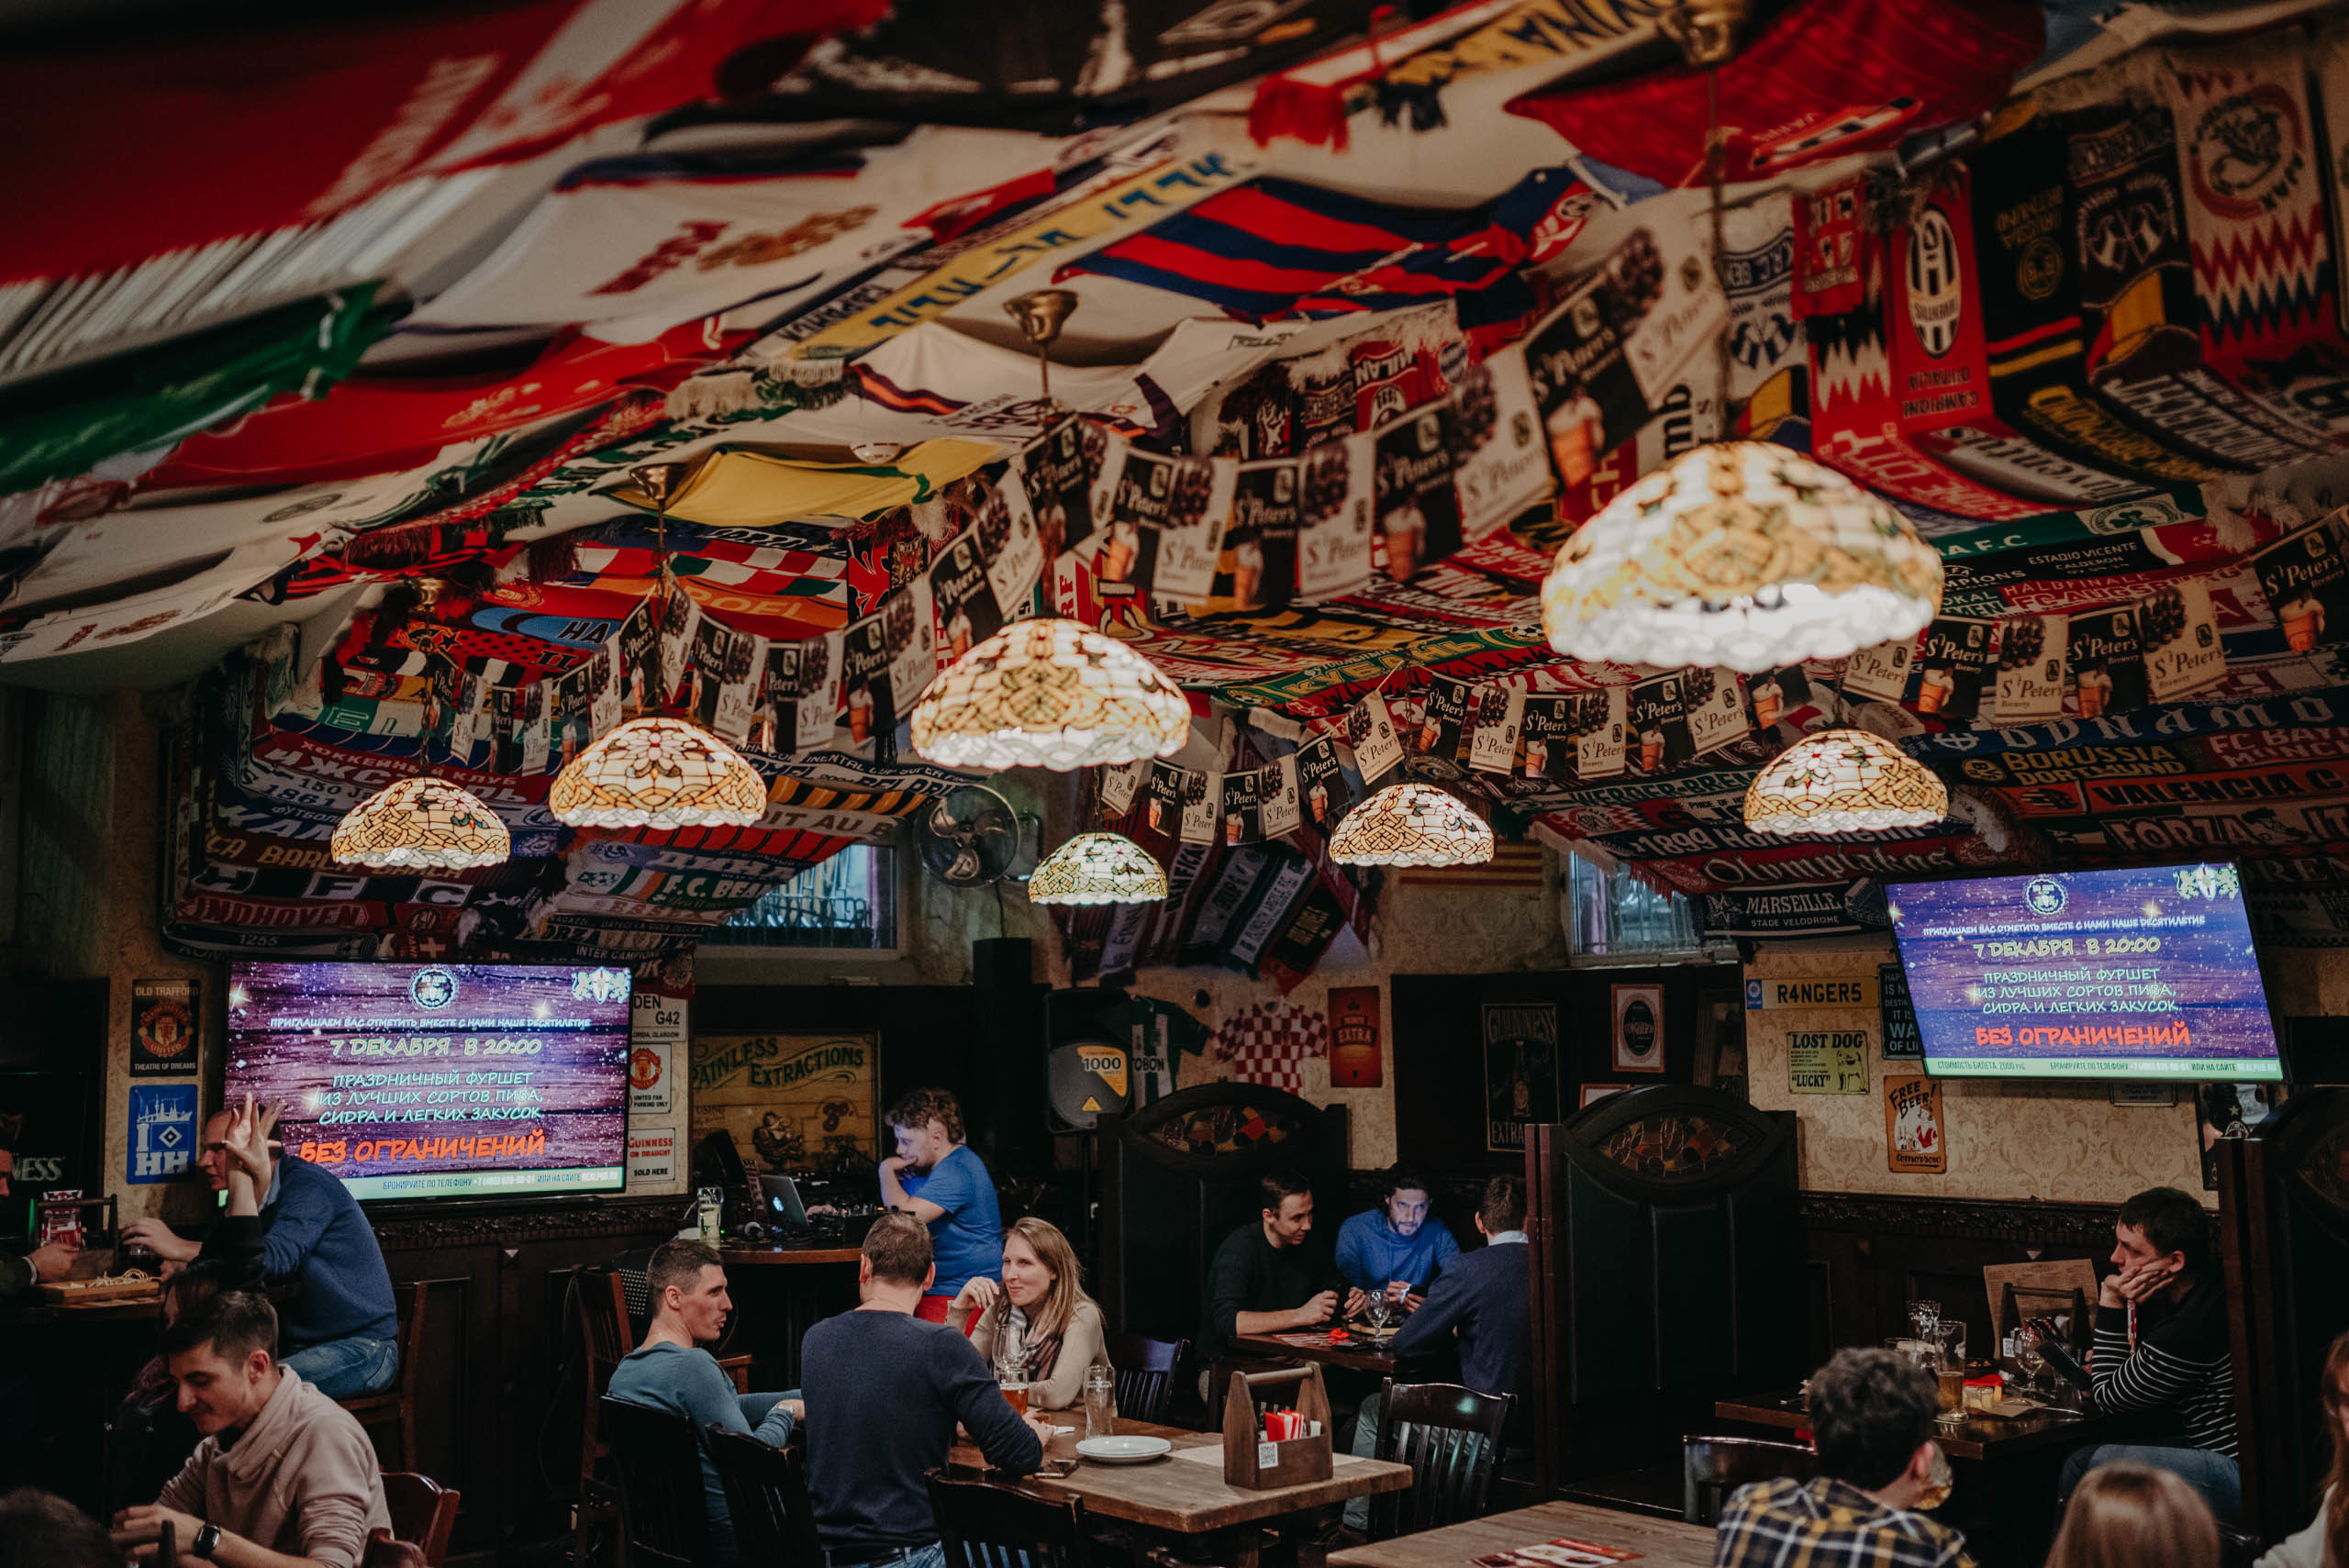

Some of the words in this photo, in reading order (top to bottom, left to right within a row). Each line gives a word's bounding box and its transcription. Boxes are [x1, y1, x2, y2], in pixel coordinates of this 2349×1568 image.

[1354, 349, 1414, 385] MILAN
[1902, 391, 1980, 418] CAMPIONI
[2027, 550, 2082, 566] ESTADIO
[2084, 541, 2138, 559] VICENTE
[2054, 555, 2124, 571] CALDERON
[2287, 552, 2342, 588] Peter's
[2003, 573, 2152, 596] HALBFINALE
[1942, 641, 1985, 663] Peter's
[2090, 638, 2139, 659] Peter's
[1285, 639, 1486, 695] КУБАНЬ
[2176, 648, 2225, 673] Peter's
[1867, 661, 1908, 684] Peter's
[2021, 680, 2062, 699] Peter's
[1437, 694, 1465, 717] Peter's
[1647, 700, 1685, 721] Peter's
[1537, 715, 1568, 732] Peter's
[1707, 708, 1745, 730] Peter's
[1369, 735, 1400, 761] Peter's
[1595, 741, 1625, 759] Peter's
[2210, 733, 2254, 756] FC
[2000, 745, 2177, 771] BORUSSIA
[1308, 756, 1337, 780] Peter's
[2013, 760, 2188, 786] DORTMUND
[299, 777, 341, 795] 150
[453, 771, 519, 785] КЛУБ
[264, 784, 336, 808] 1861
[1157, 777, 1177, 800] Peter's
[1232, 790, 1258, 805] Peter's
[2091, 773, 2306, 807] VALENCIA
[1688, 799, 1716, 809] PRIDE
[1719, 798, 1728, 806] OF
[813, 815, 863, 831] AU
[2100, 813, 2255, 853] FORZA
[1746, 892, 1843, 916] MARSEILLE
[1751, 917, 1781, 928] STADE
[1783, 915, 1841, 927] VELODROME
[1923, 926, 1977, 936] ПРИГЛАШАЕМ
[1979, 925, 1996, 934] ВАС
[1997, 923, 2040, 933] ОТМЕТИТЬ
[2042, 922, 2074, 931] ВМЕСТЕ
[2084, 920, 2110, 929] НАМИ
[2112, 918, 2139, 929] НАШЕ
[2140, 915, 2205, 928] ДЕСЯТИЛЕТИЕ
[237, 933, 279, 947] 1255
[1974, 943, 1985, 957] 7
[1988, 939, 2074, 956] ДЕКАБРЯ
[2086, 939, 2099, 955] В
[2105, 937, 2161, 954] 20:00
[576, 945, 607, 959] INTER
[1984, 967, 2091, 984] ПРАЗДНИЧНЫЙ
[2097, 967, 2160, 981] ФУРШЕТ
[135, 986, 152, 996] OLD
[155, 985, 198, 996] TRAFFORD
[1886, 984, 1894, 994] IS
[1977, 988, 1996, 999] ИЗ
[1999, 986, 2062, 999] ЛУЧШИХ
[2066, 984, 2123, 997] СОРТОВ
[2128, 983, 2176, 997] ПИВА,
[1894, 1010, 1901, 1019] IT
[1983, 1002, 2031, 1014] СИДРА
[2034, 1001, 2045, 1013] И
[2049, 1000, 2106, 1014] ЛЕГКИХ
[270, 1017, 341, 1028] ПРИГЛАШАЕМ
[344, 1017, 364, 1028] ВАС
[366, 1018, 417, 1028] ОТМЕТИТЬ
[419, 1018, 457, 1028] ВМЕСТЕ
[467, 1018, 496, 1028] НАМИ
[498, 1018, 526, 1028] НАШЕ
[527, 1018, 592, 1029] ДЕСЯТИЛЕТИЕ
[655, 1011, 680, 1026] G42
[1488, 1009, 1557, 1043] GUINNESS
[1336, 1029, 1373, 1043] EXTRA
[1792, 1034, 1828, 1049] LOST
[1832, 1034, 1863, 1049] DOG
[1976, 1027, 2013, 1045] БЕЗ
[2020, 1020, 2191, 1046] ОГРАНИЧЕНИЙ
[330, 1040, 345, 1056] 7
[350, 1038, 451, 1056] ДЕКАБРЯ
[464, 1038, 478, 1055] В
[484, 1038, 541, 1055] 20:00
[1889, 1040, 1905, 1051] OF
[134, 1063, 159, 1072] THEATRE
[171, 1062, 196, 1071] DREAMS
[750, 1047, 863, 1086] EXTRACTIONS
[1083, 1057, 1121, 1071] 1000
[332, 1069, 460, 1088] ПРАЗДНИЧНЫЙ
[465, 1072, 534, 1086] ФУРШЕТ
[318, 1091, 341, 1106] ИЗ
[345, 1091, 422, 1106] ЛУЧШИХ
[427, 1089, 490, 1105] СОРТОВ
[1889, 1081, 1920, 1110] FREE
[318, 1110, 378, 1126] СИДРА
[384, 1110, 397, 1123] И
[401, 1108, 466, 1123] ЛЕГКИХ
[299, 1140, 348, 1164] БЕЗ
[353, 1129, 546, 1164] ОГРАНИЧЕНИЙ
[629, 1137, 674, 1148] GUINNESS
[630, 1150, 640, 1158] ON
[641, 1150, 671, 1158] DRAUGHT
